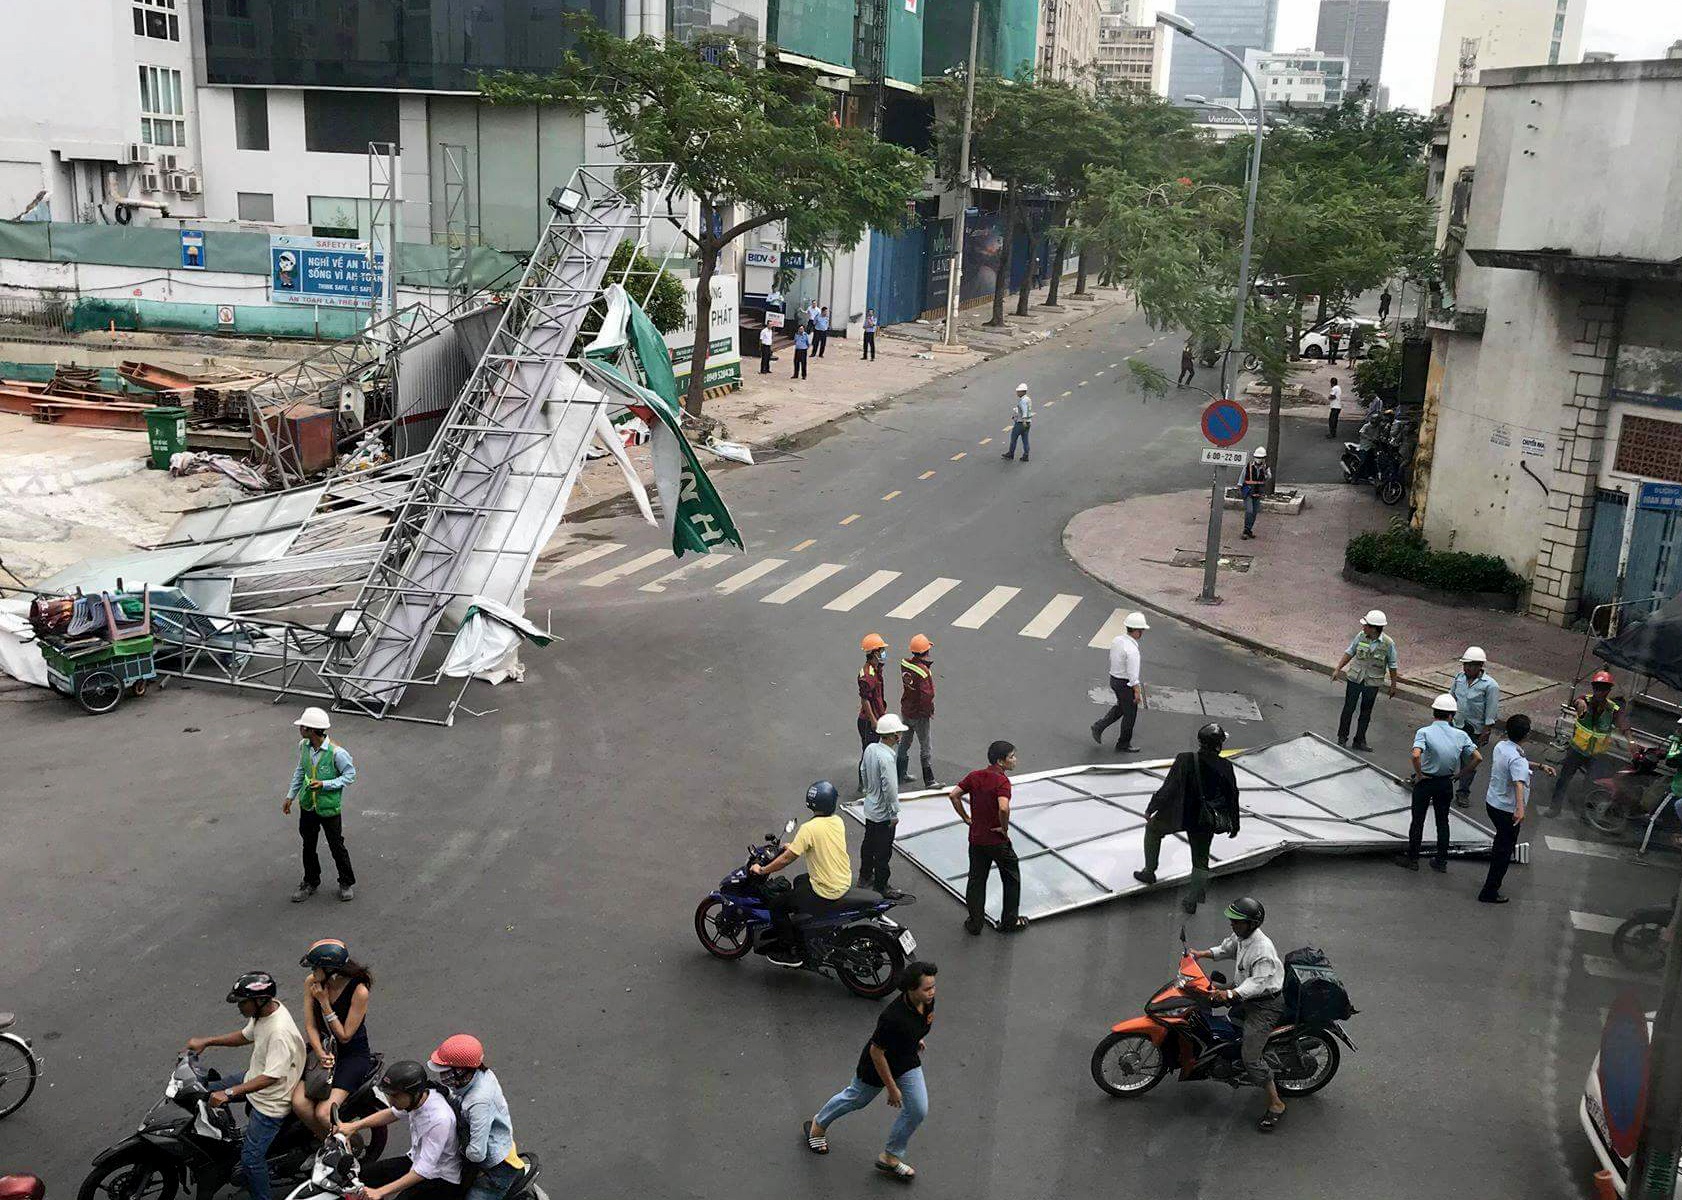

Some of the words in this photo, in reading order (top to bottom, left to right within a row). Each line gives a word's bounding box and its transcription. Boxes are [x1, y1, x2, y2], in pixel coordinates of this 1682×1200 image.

[316, 240, 347, 249] SAFETY
[748, 253, 769, 263] BIDV
[346, 259, 358, 269] AN
[308, 267, 332, 280] SỐNG
[346, 271, 359, 281] AN
[711, 304, 733, 327] PHÁT
